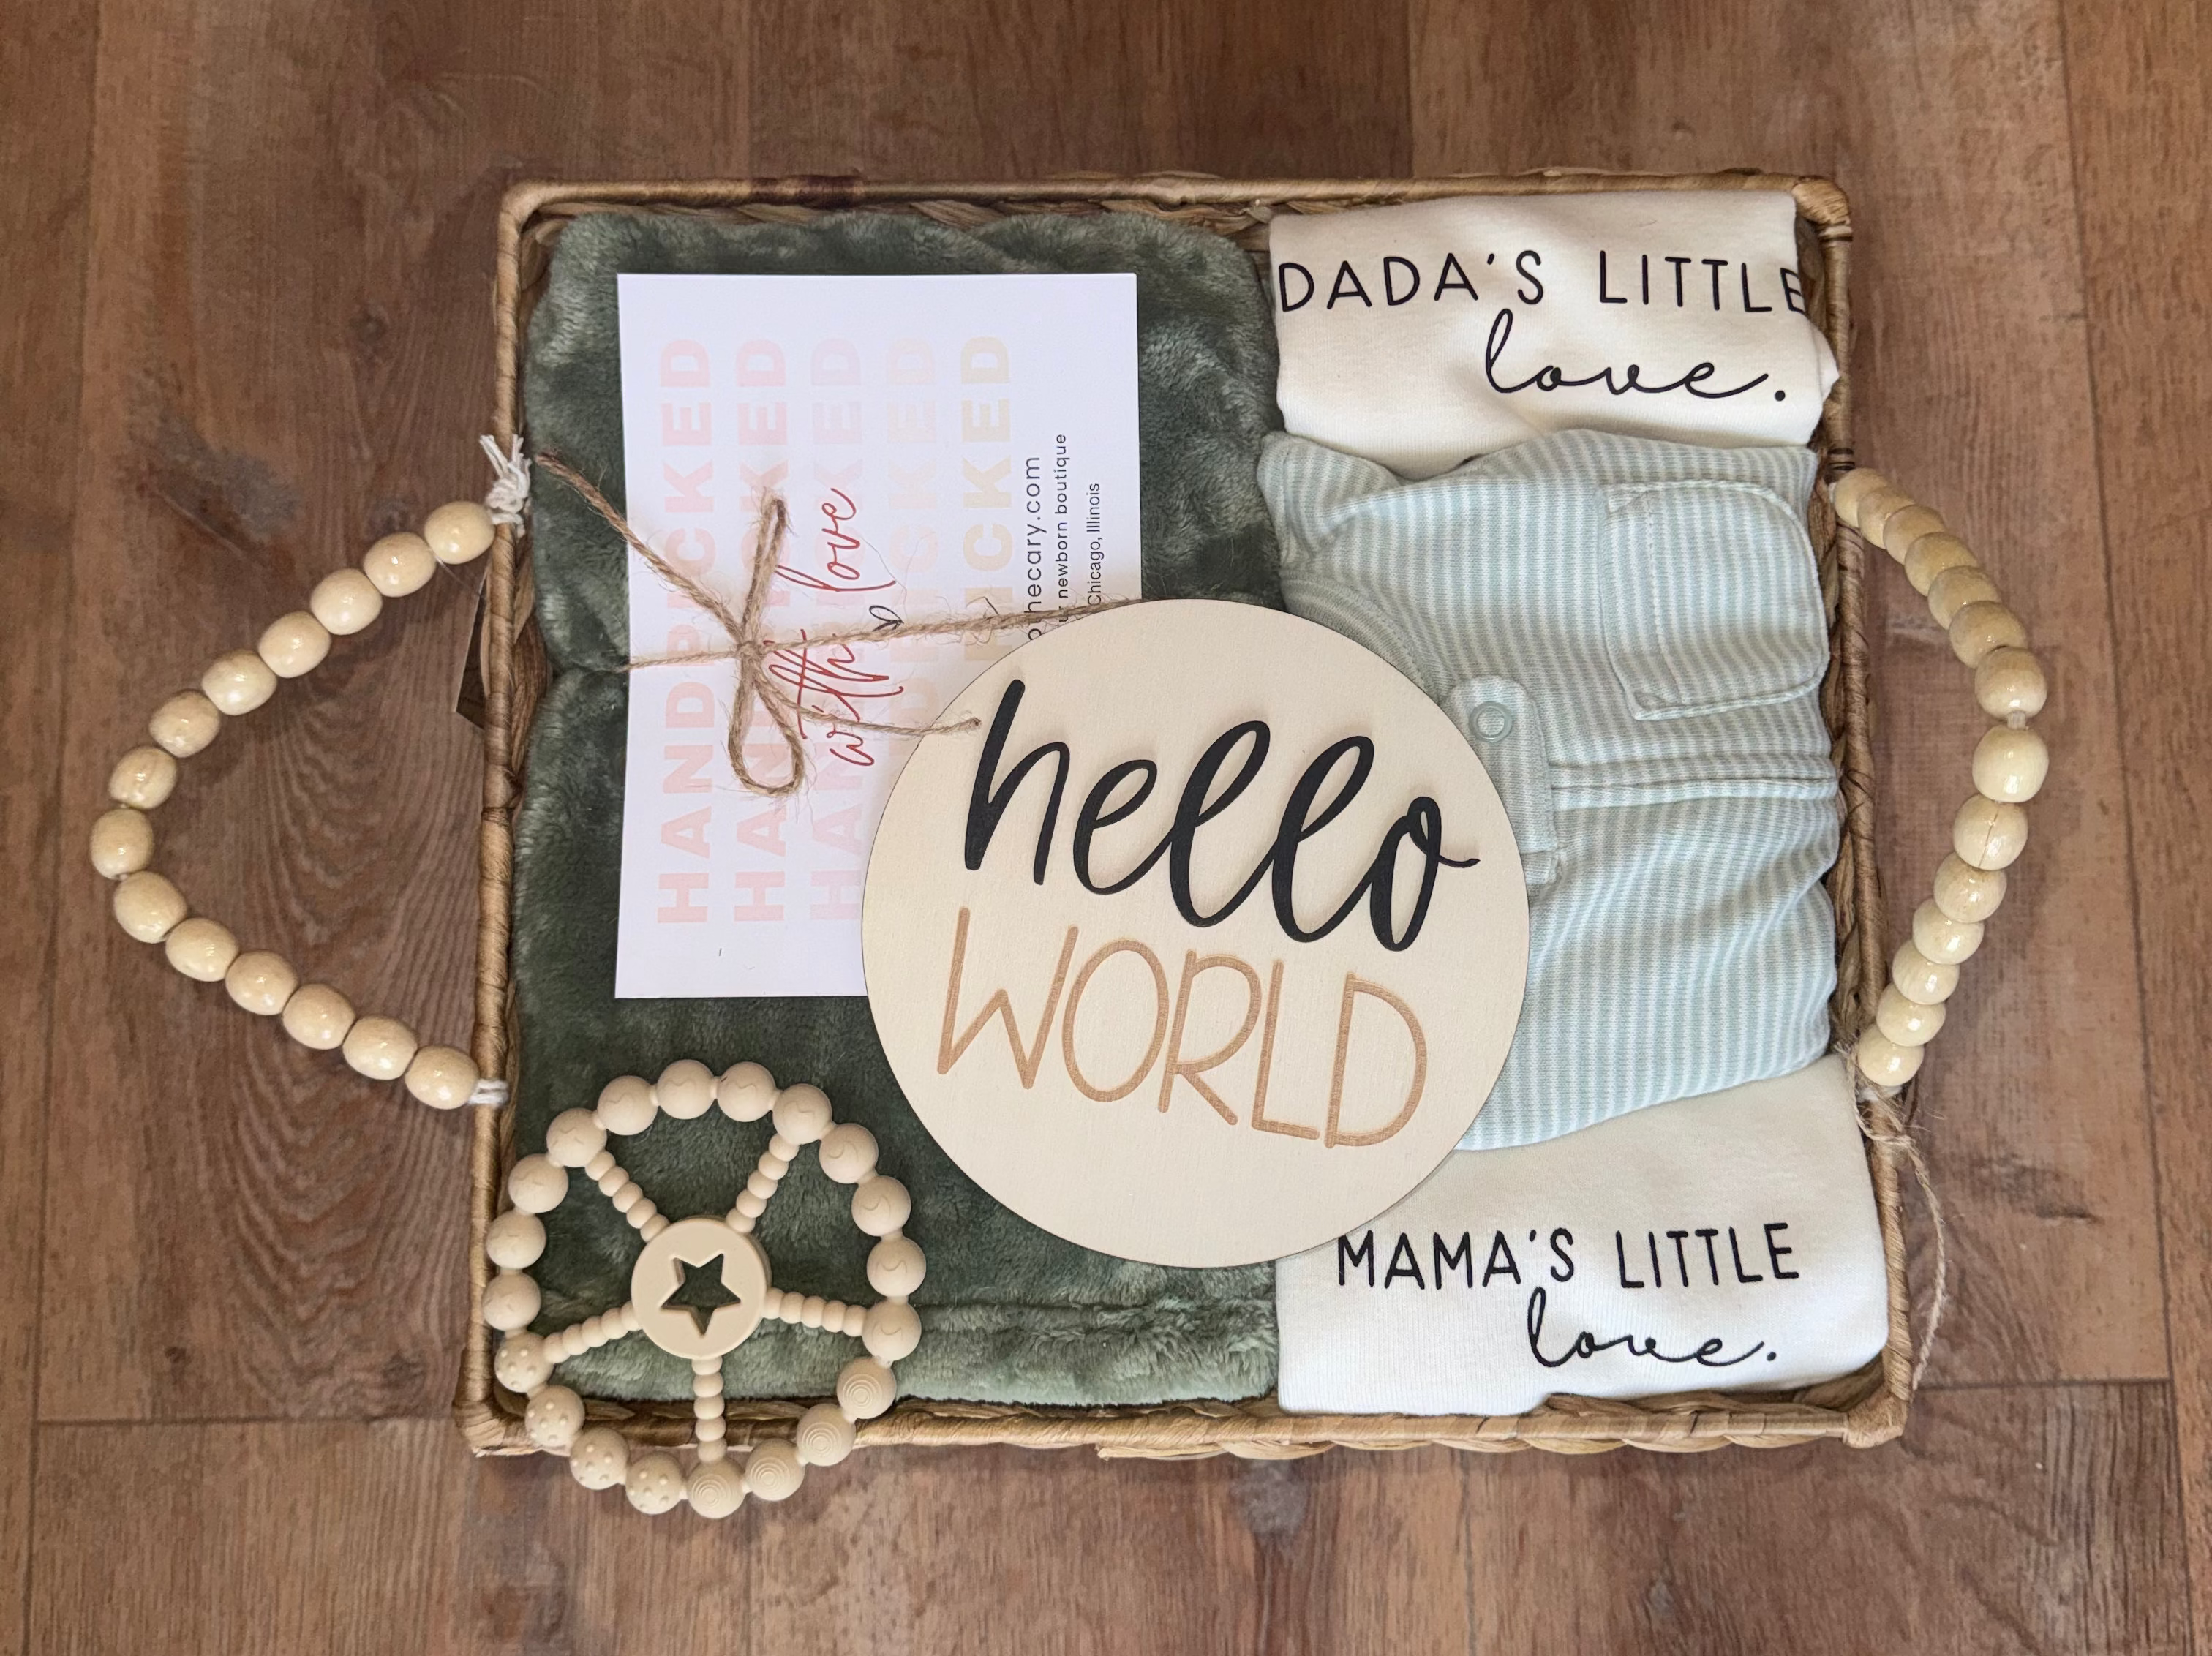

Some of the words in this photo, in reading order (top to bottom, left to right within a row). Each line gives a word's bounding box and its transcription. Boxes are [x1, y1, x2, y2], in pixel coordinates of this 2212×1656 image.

[1278, 249, 1545, 312] DADA'S
[1599, 250, 1807, 313] LITTLE
[1485, 307, 1786, 402] love.
[1053, 434, 1071, 515] boutique
[1086, 483, 1102, 533] Illinois
[773, 487, 896, 592] love
[1054, 522, 1069, 599] newborn
[1086, 537, 1105, 607] Chicago,
[734, 338, 791, 922] HANKED
[762, 628, 904, 767] with
[964, 679, 1481, 952] hello
[936, 906, 1428, 1149] WORLD
[1337, 1227, 1575, 1290] MAMA'S
[1615, 1222, 1800, 1289] LITTLE
[1526, 1285, 1778, 1368] love.
